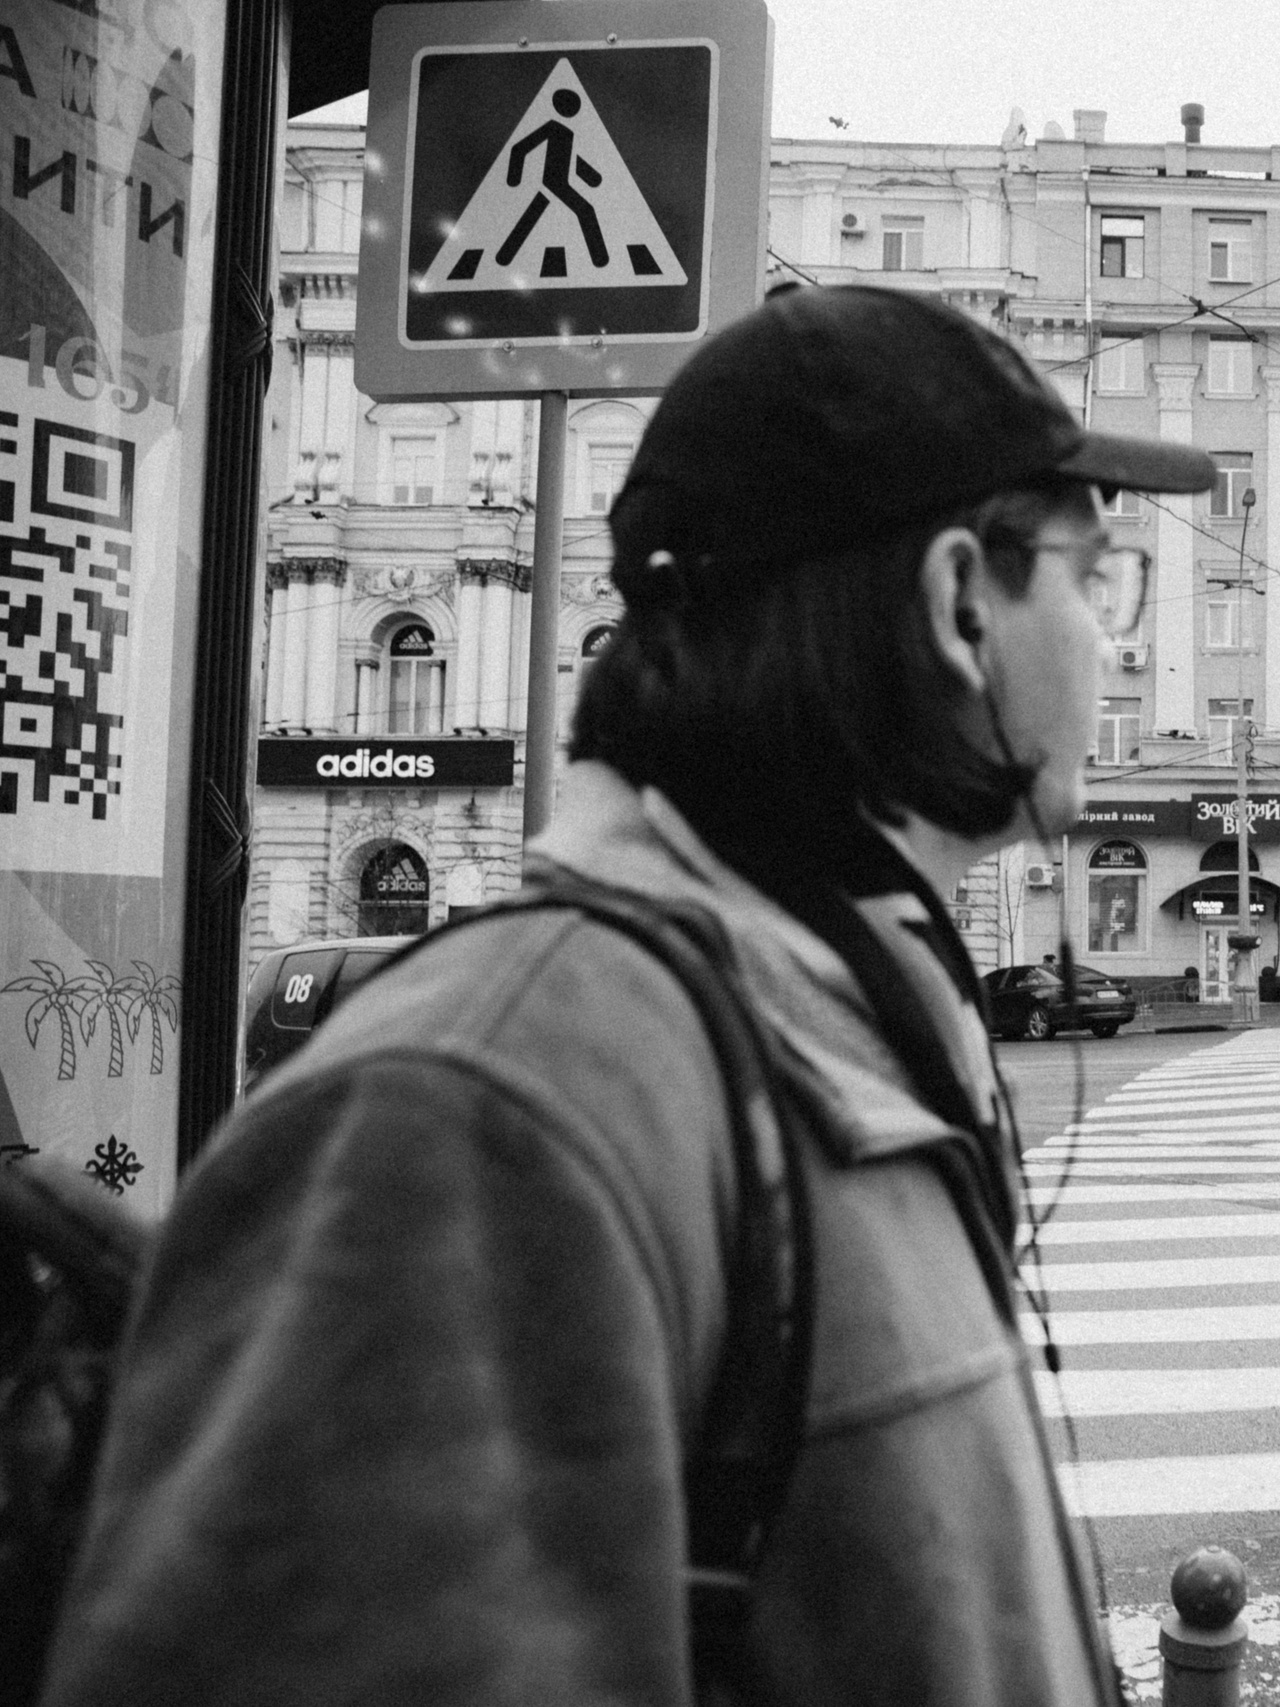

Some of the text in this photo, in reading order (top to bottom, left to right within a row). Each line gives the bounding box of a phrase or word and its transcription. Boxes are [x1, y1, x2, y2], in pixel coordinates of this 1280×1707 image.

[316, 749, 435, 778] adidas
[1077, 810, 1155, 823] лірний завод
[377, 878, 426, 892] adidas
[285, 974, 313, 1003] 08
